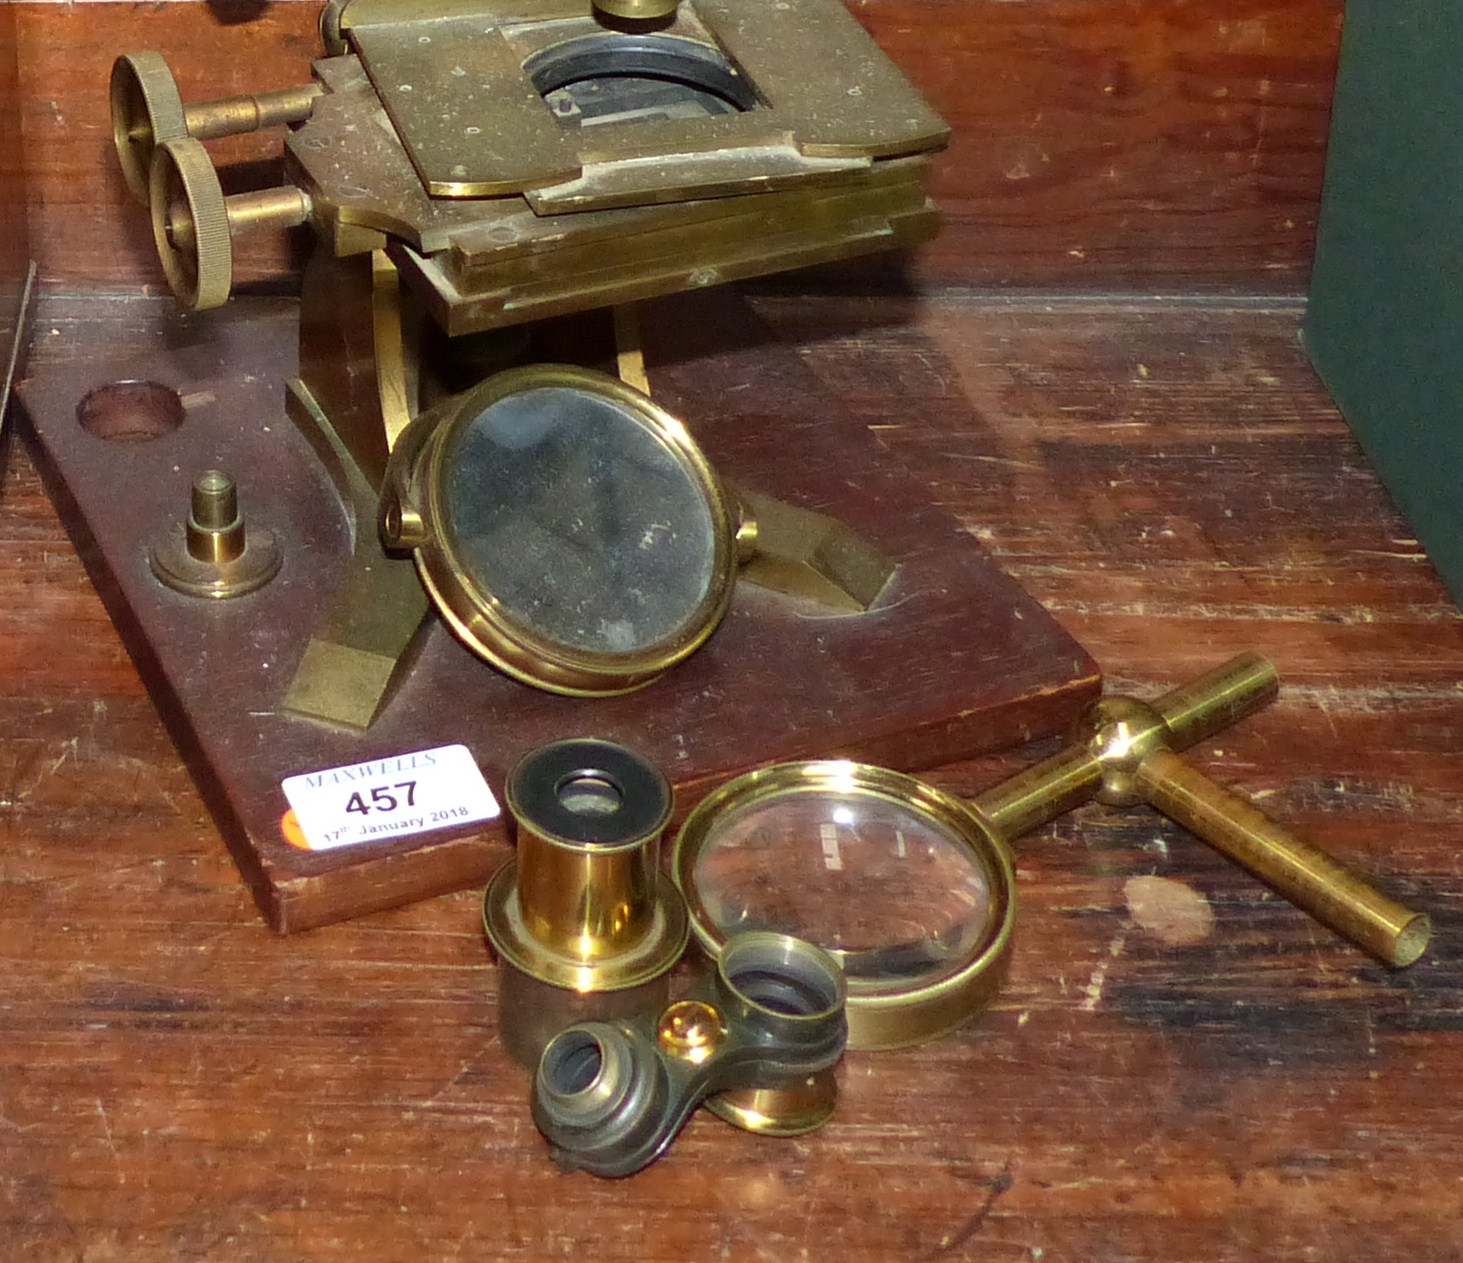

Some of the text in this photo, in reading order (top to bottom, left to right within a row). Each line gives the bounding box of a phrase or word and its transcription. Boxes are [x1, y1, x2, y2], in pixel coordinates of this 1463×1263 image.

[305, 751, 436, 790] MAXWELLS
[345, 780, 418, 816] 457
[359, 817, 424, 836] January
[429, 806, 469, 823] 2018
